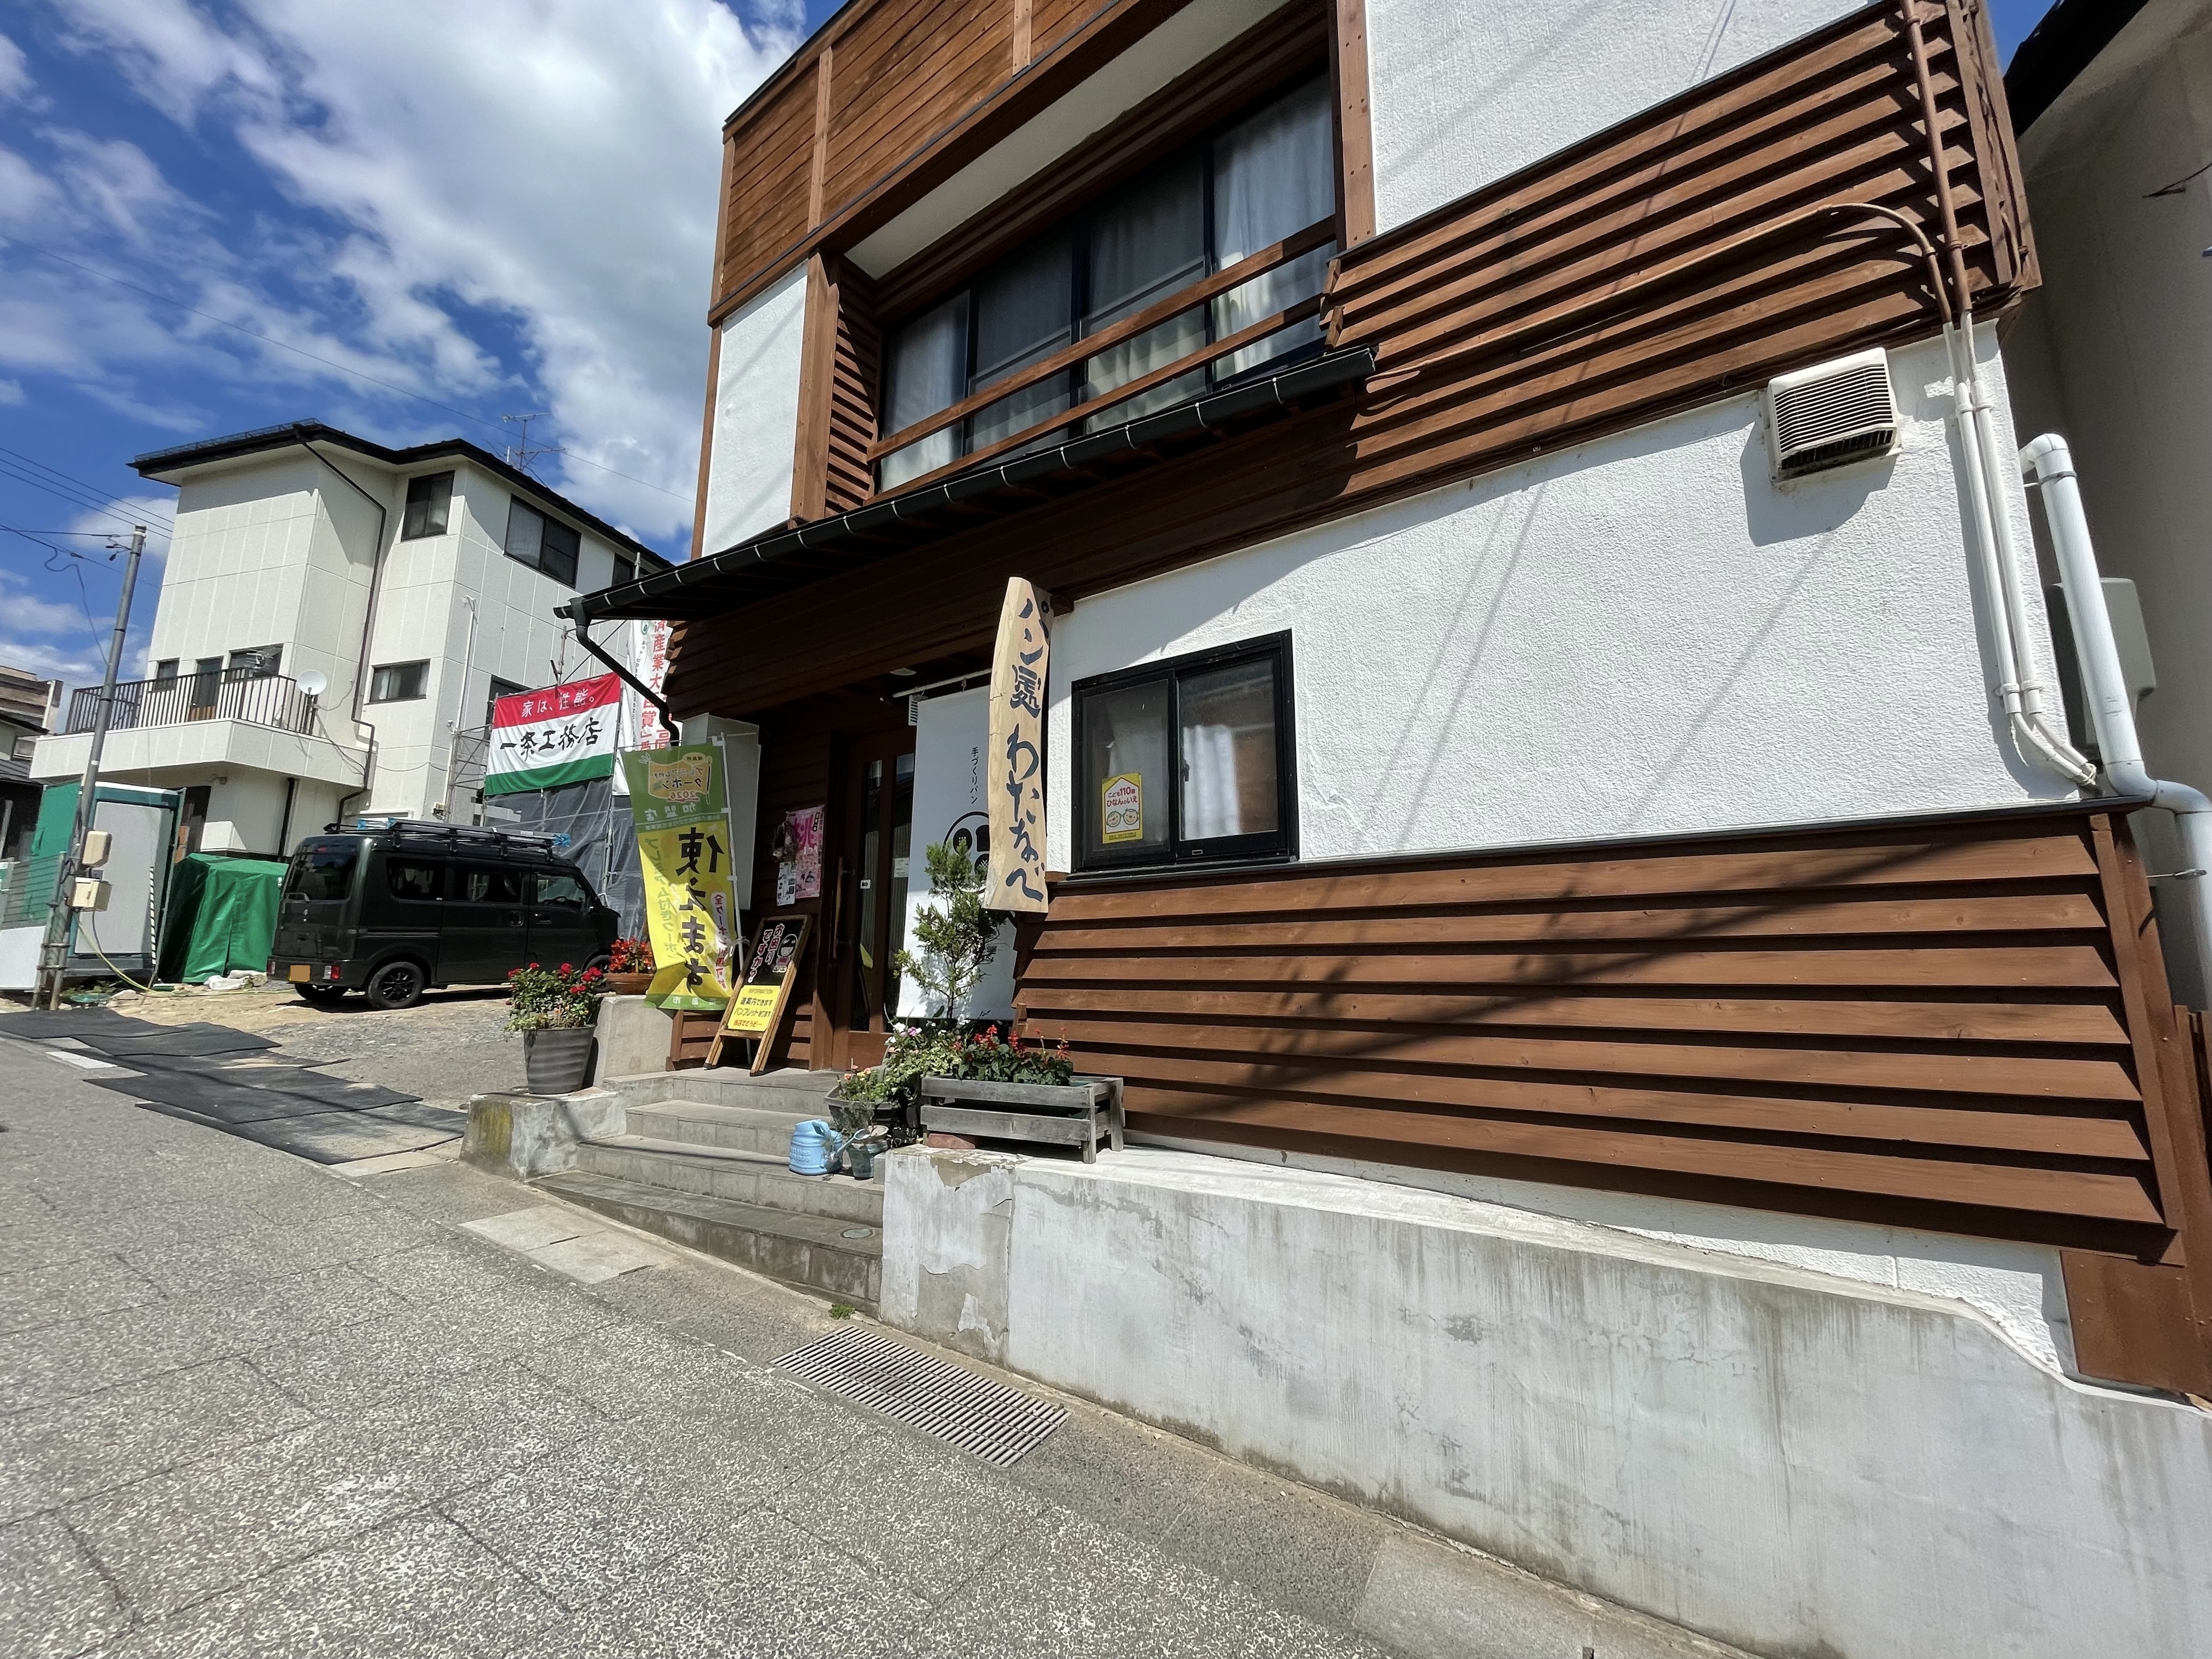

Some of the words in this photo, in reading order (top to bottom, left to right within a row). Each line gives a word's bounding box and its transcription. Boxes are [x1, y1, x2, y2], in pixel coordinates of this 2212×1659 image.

[521, 688, 595, 718] 家は、性能。
[500, 717, 603, 761] 一条工務店
[970, 746, 979, 804] 手づくりパン
